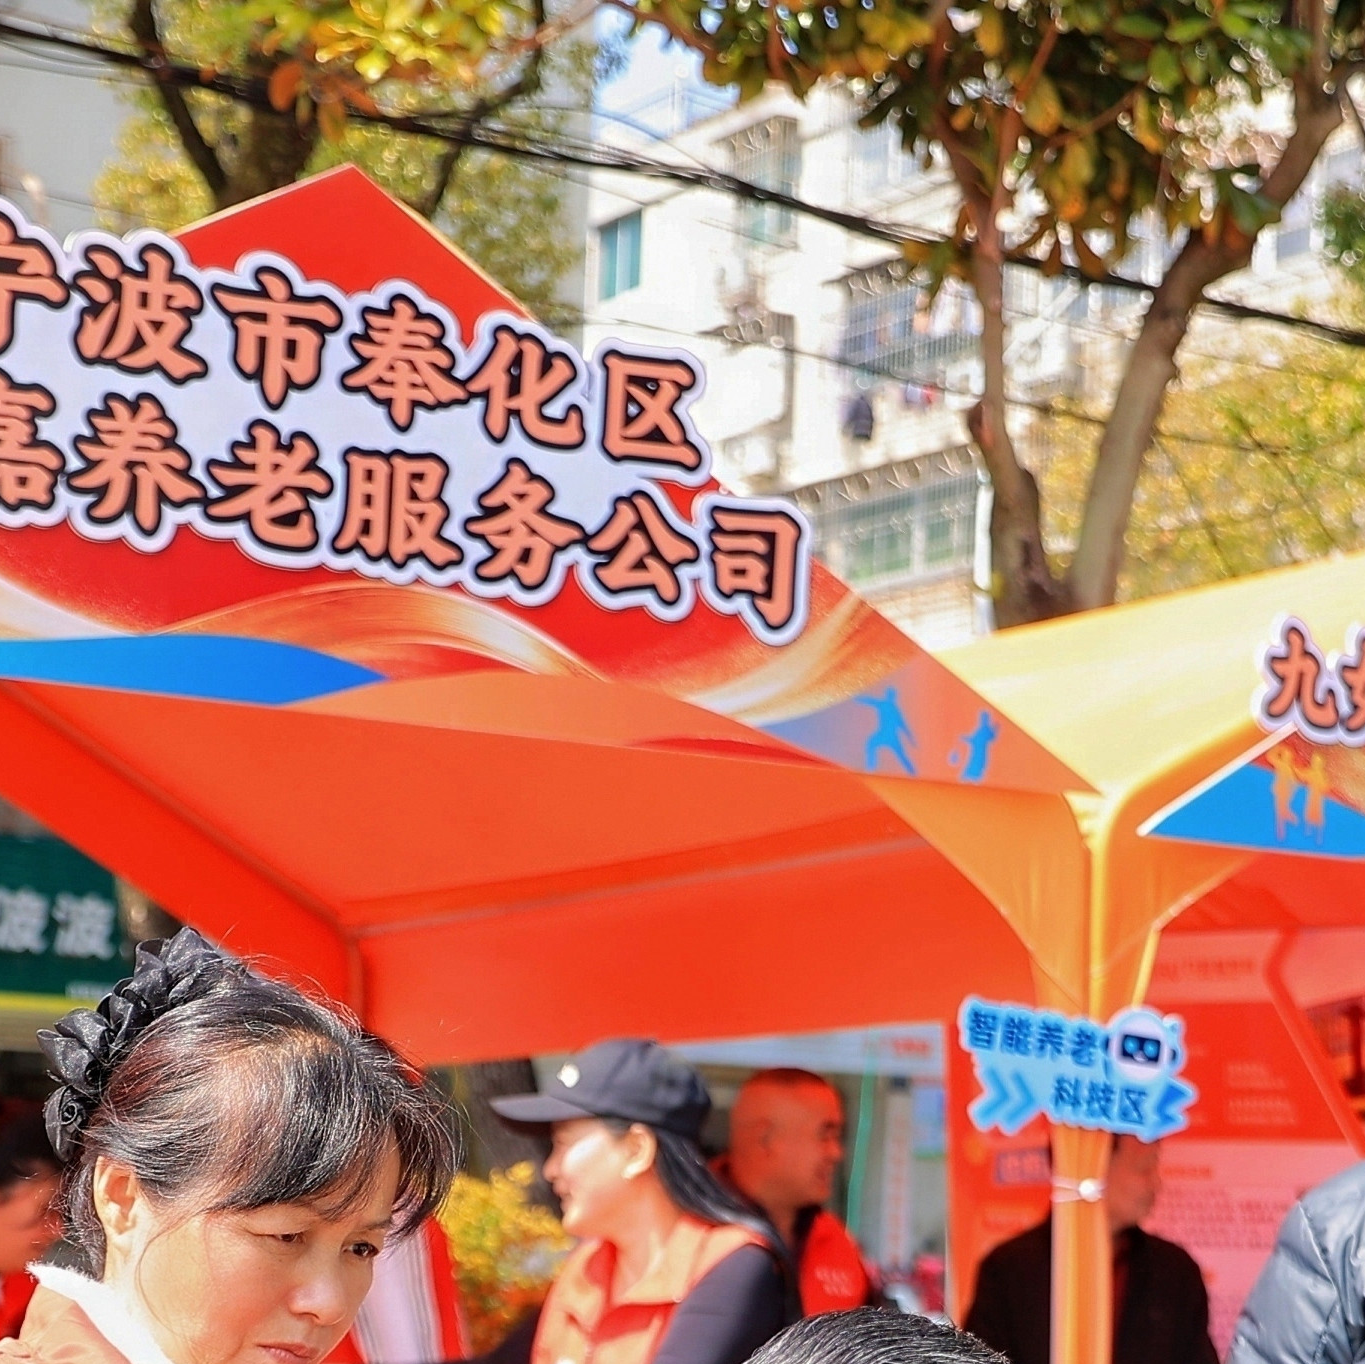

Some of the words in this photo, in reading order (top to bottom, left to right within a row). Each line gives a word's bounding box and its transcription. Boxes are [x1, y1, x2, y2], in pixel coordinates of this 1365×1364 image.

[968, 1007, 1097, 1067] 智能养老
[1054, 1075, 1148, 1126] 科技区
